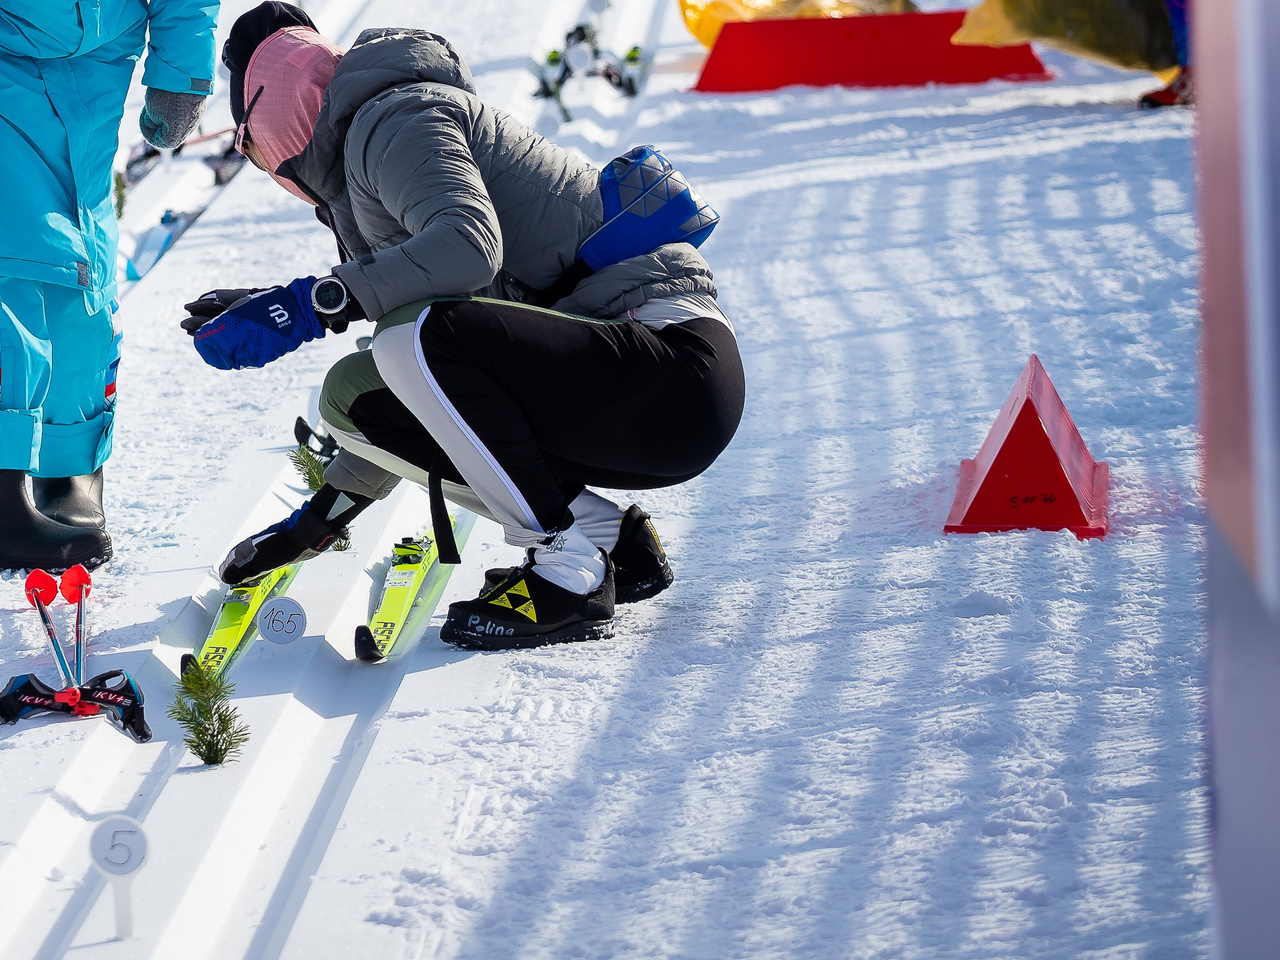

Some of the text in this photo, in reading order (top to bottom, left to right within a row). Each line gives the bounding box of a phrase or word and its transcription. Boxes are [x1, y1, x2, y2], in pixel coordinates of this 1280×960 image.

[263, 607, 304, 635] 165
[467, 613, 515, 637] Polina
[103, 829, 137, 866] 5
